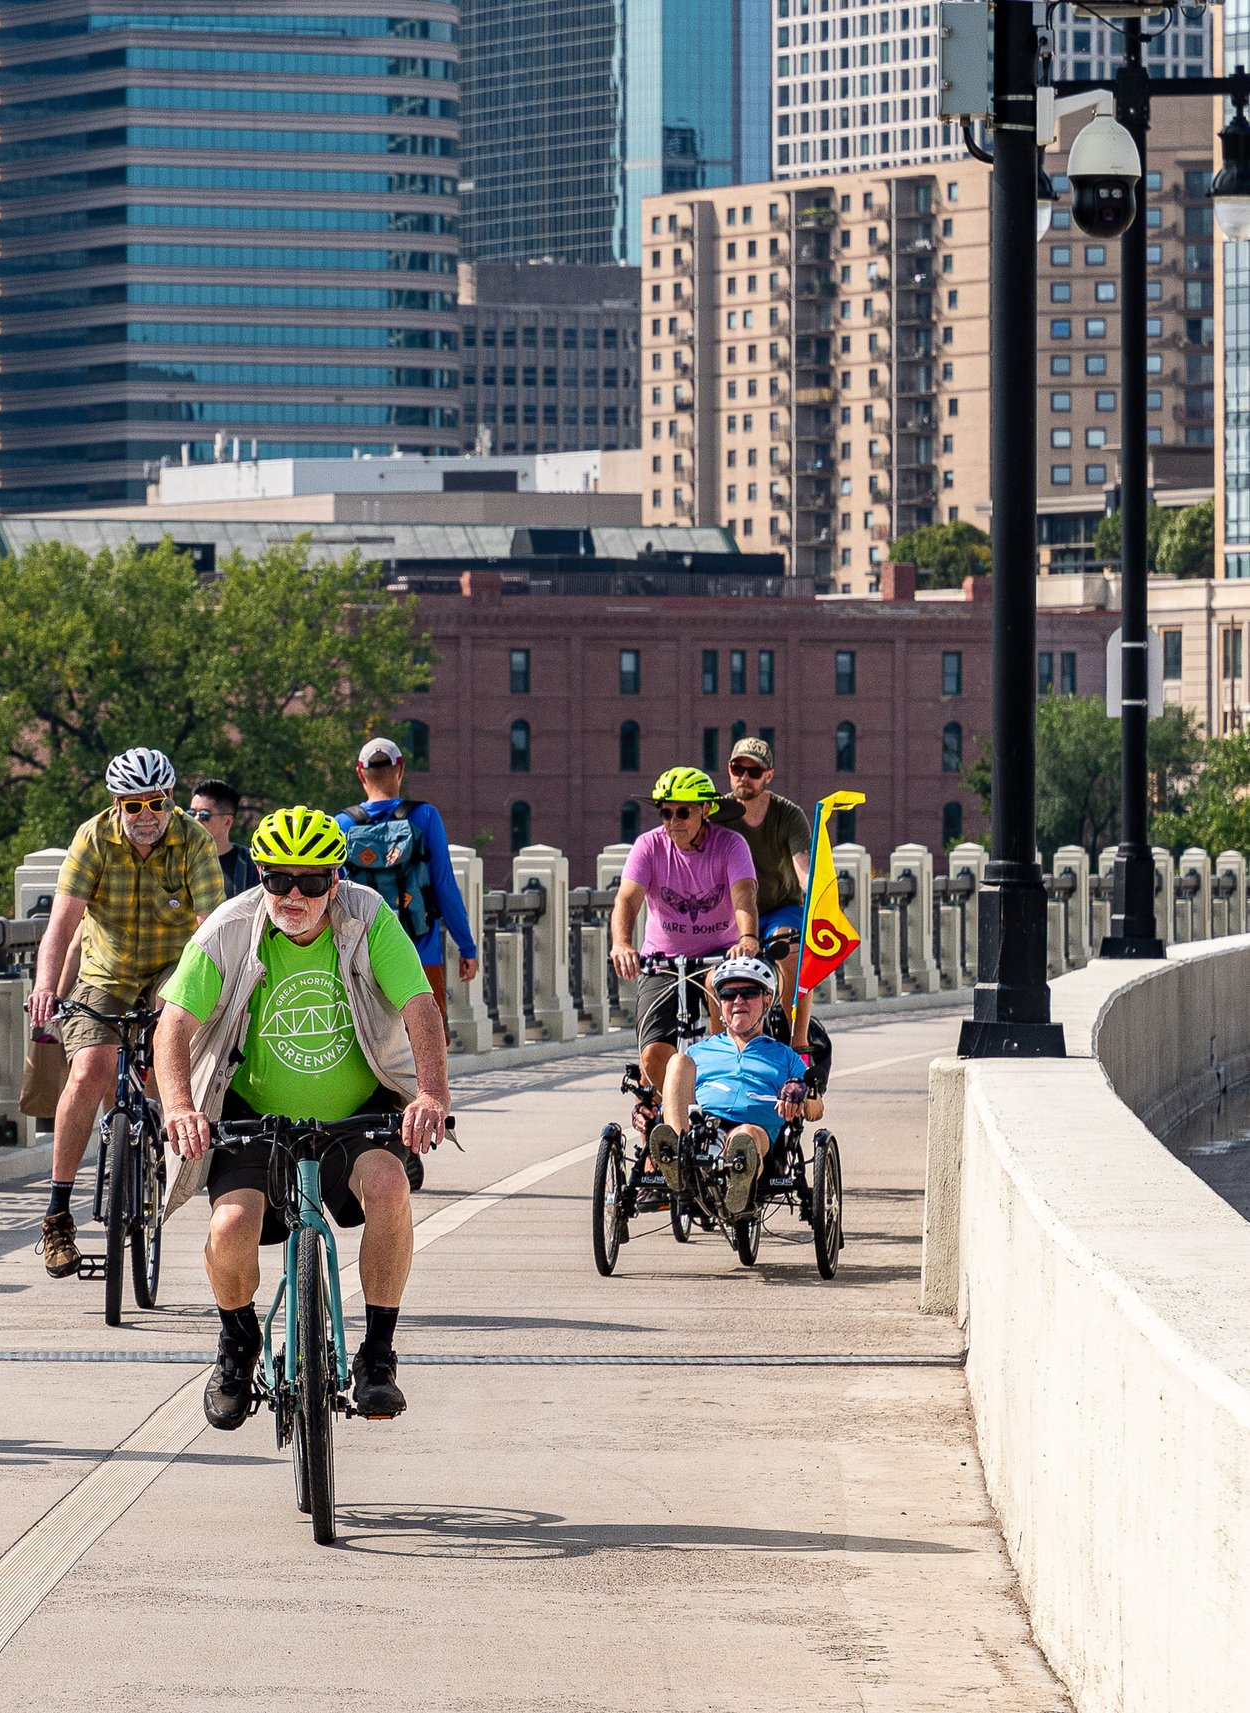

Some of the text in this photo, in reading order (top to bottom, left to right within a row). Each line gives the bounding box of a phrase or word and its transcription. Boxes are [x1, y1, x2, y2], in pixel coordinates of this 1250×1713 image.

[692, 921, 729, 934] BONES
[276, 984, 297, 1006] GREAT
[277, 1033, 349, 1067] GREENWAY
